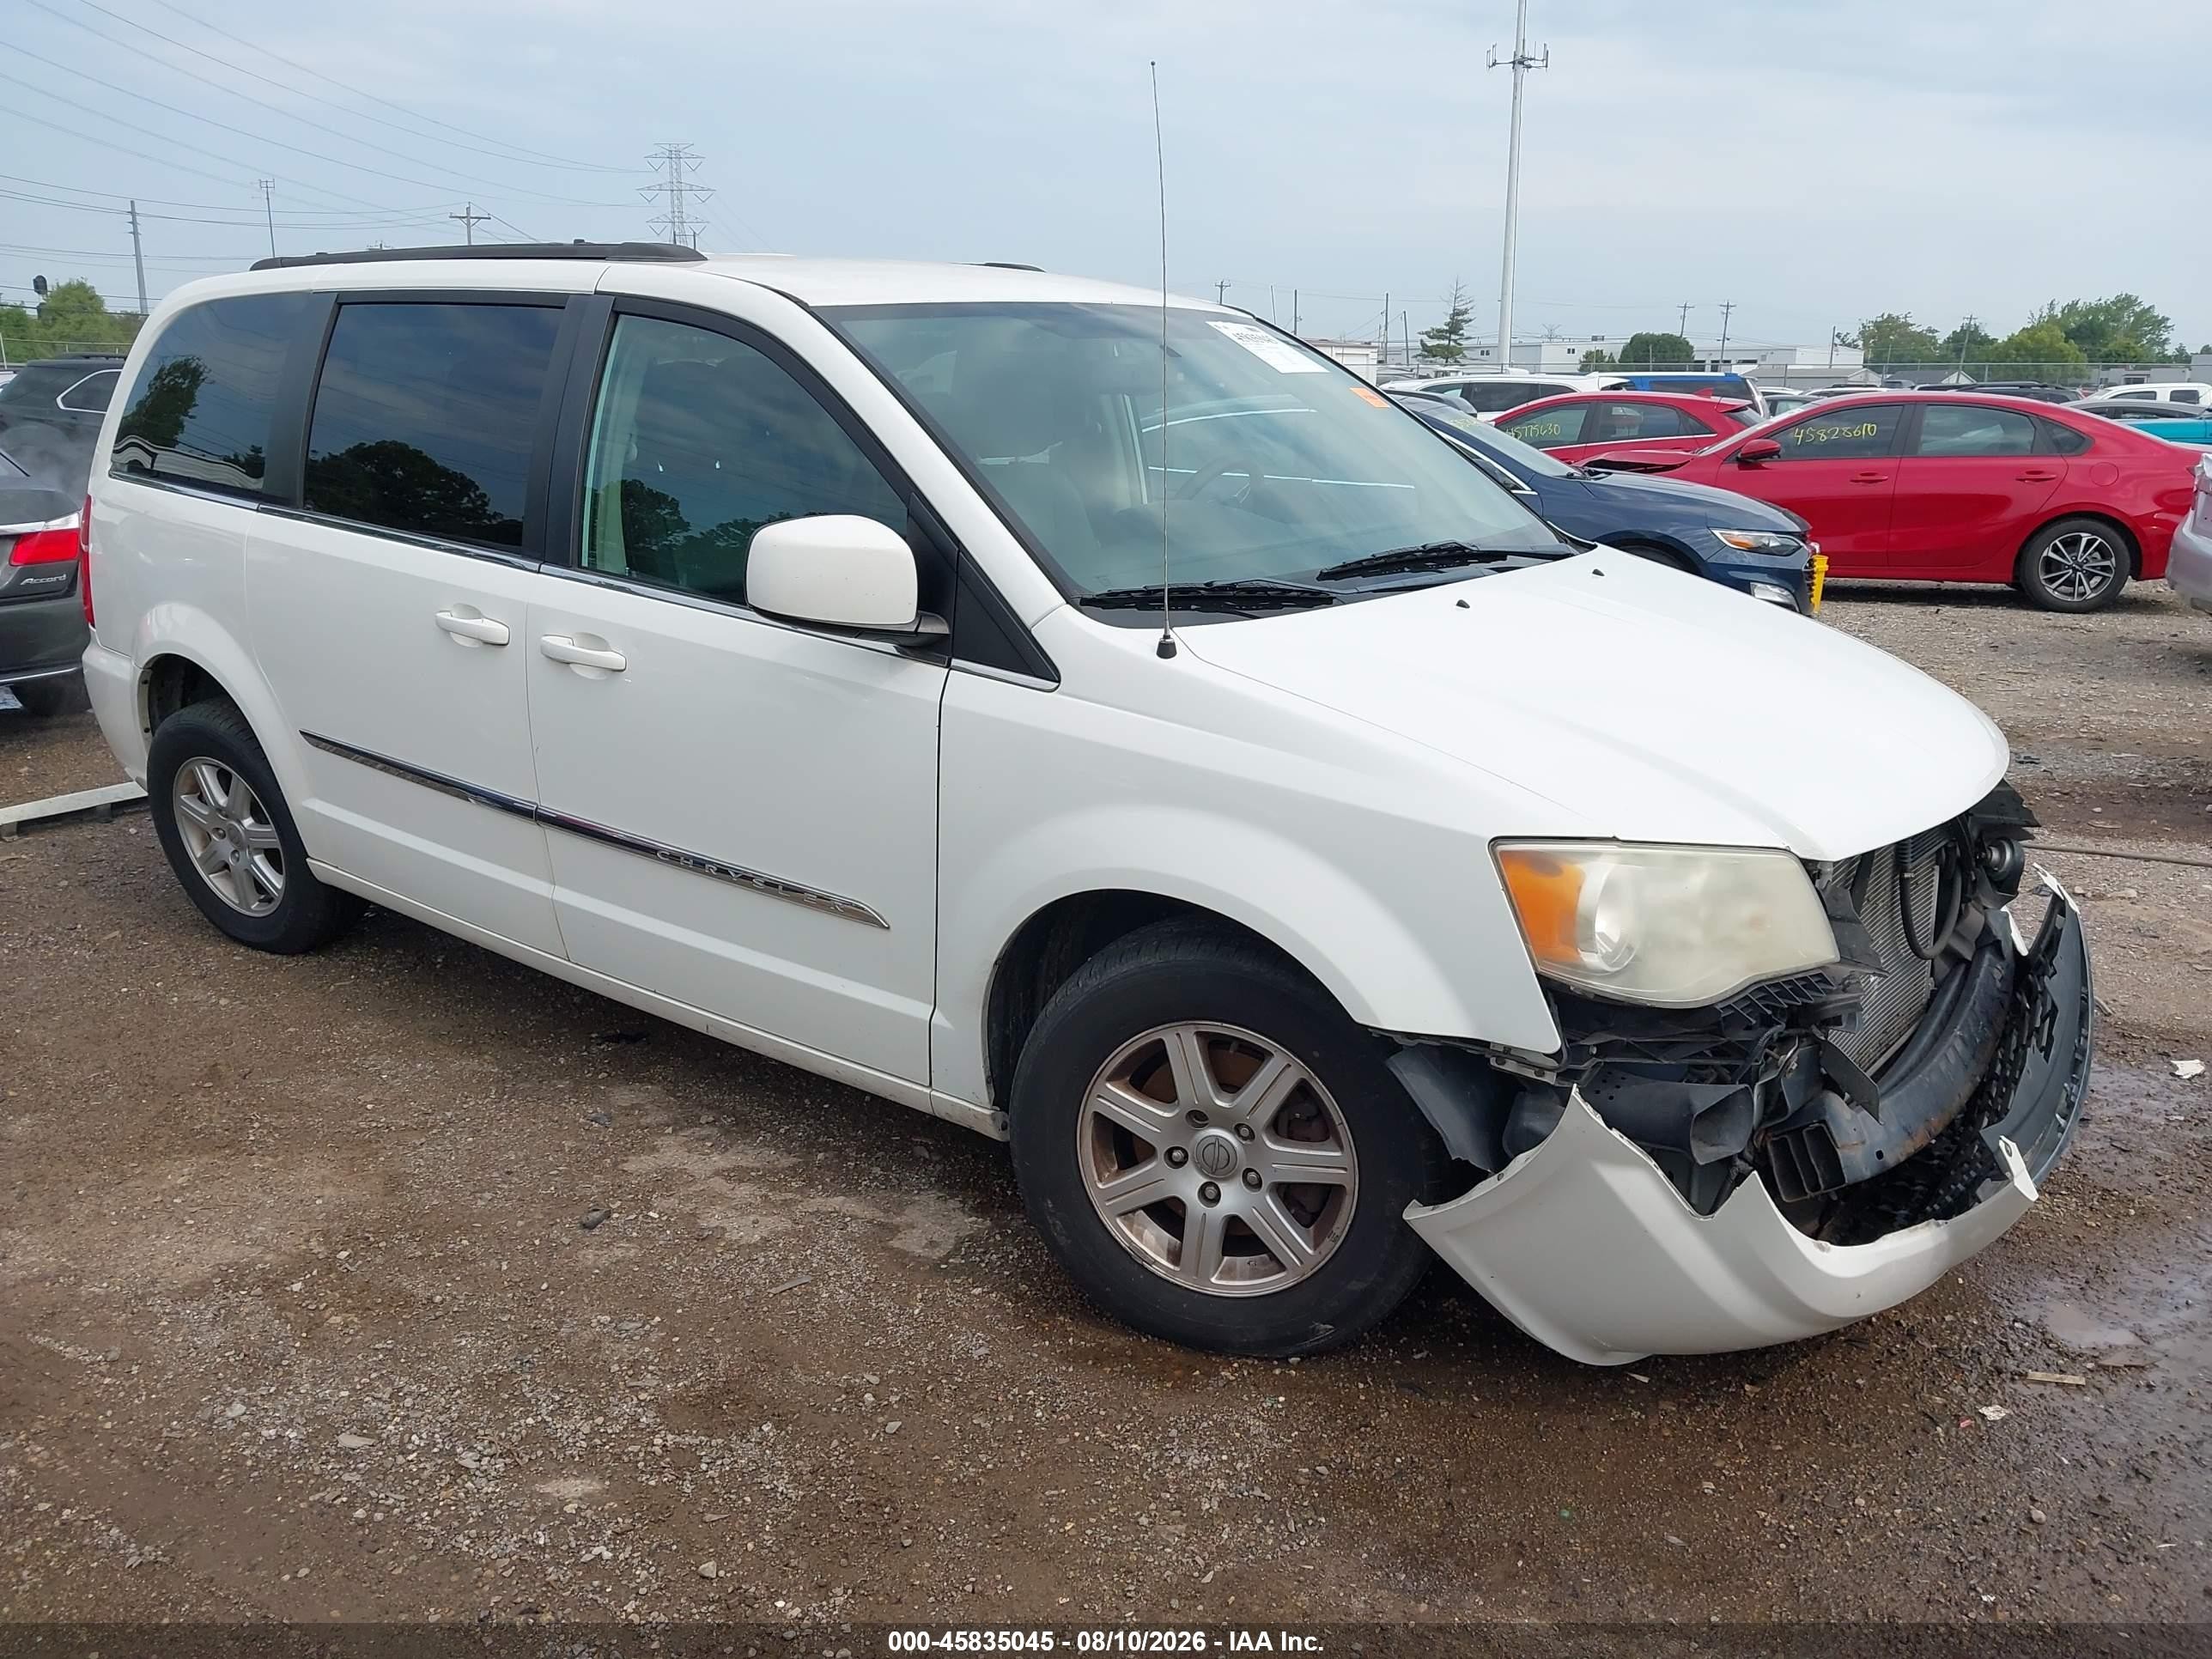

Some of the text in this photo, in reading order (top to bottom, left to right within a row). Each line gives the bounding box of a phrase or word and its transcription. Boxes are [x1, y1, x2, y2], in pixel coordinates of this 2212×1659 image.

[1793, 422, 1877, 446] 45828610
[20, 574, 67, 586] Accord
[656, 849, 846, 913] CHRYSLER
